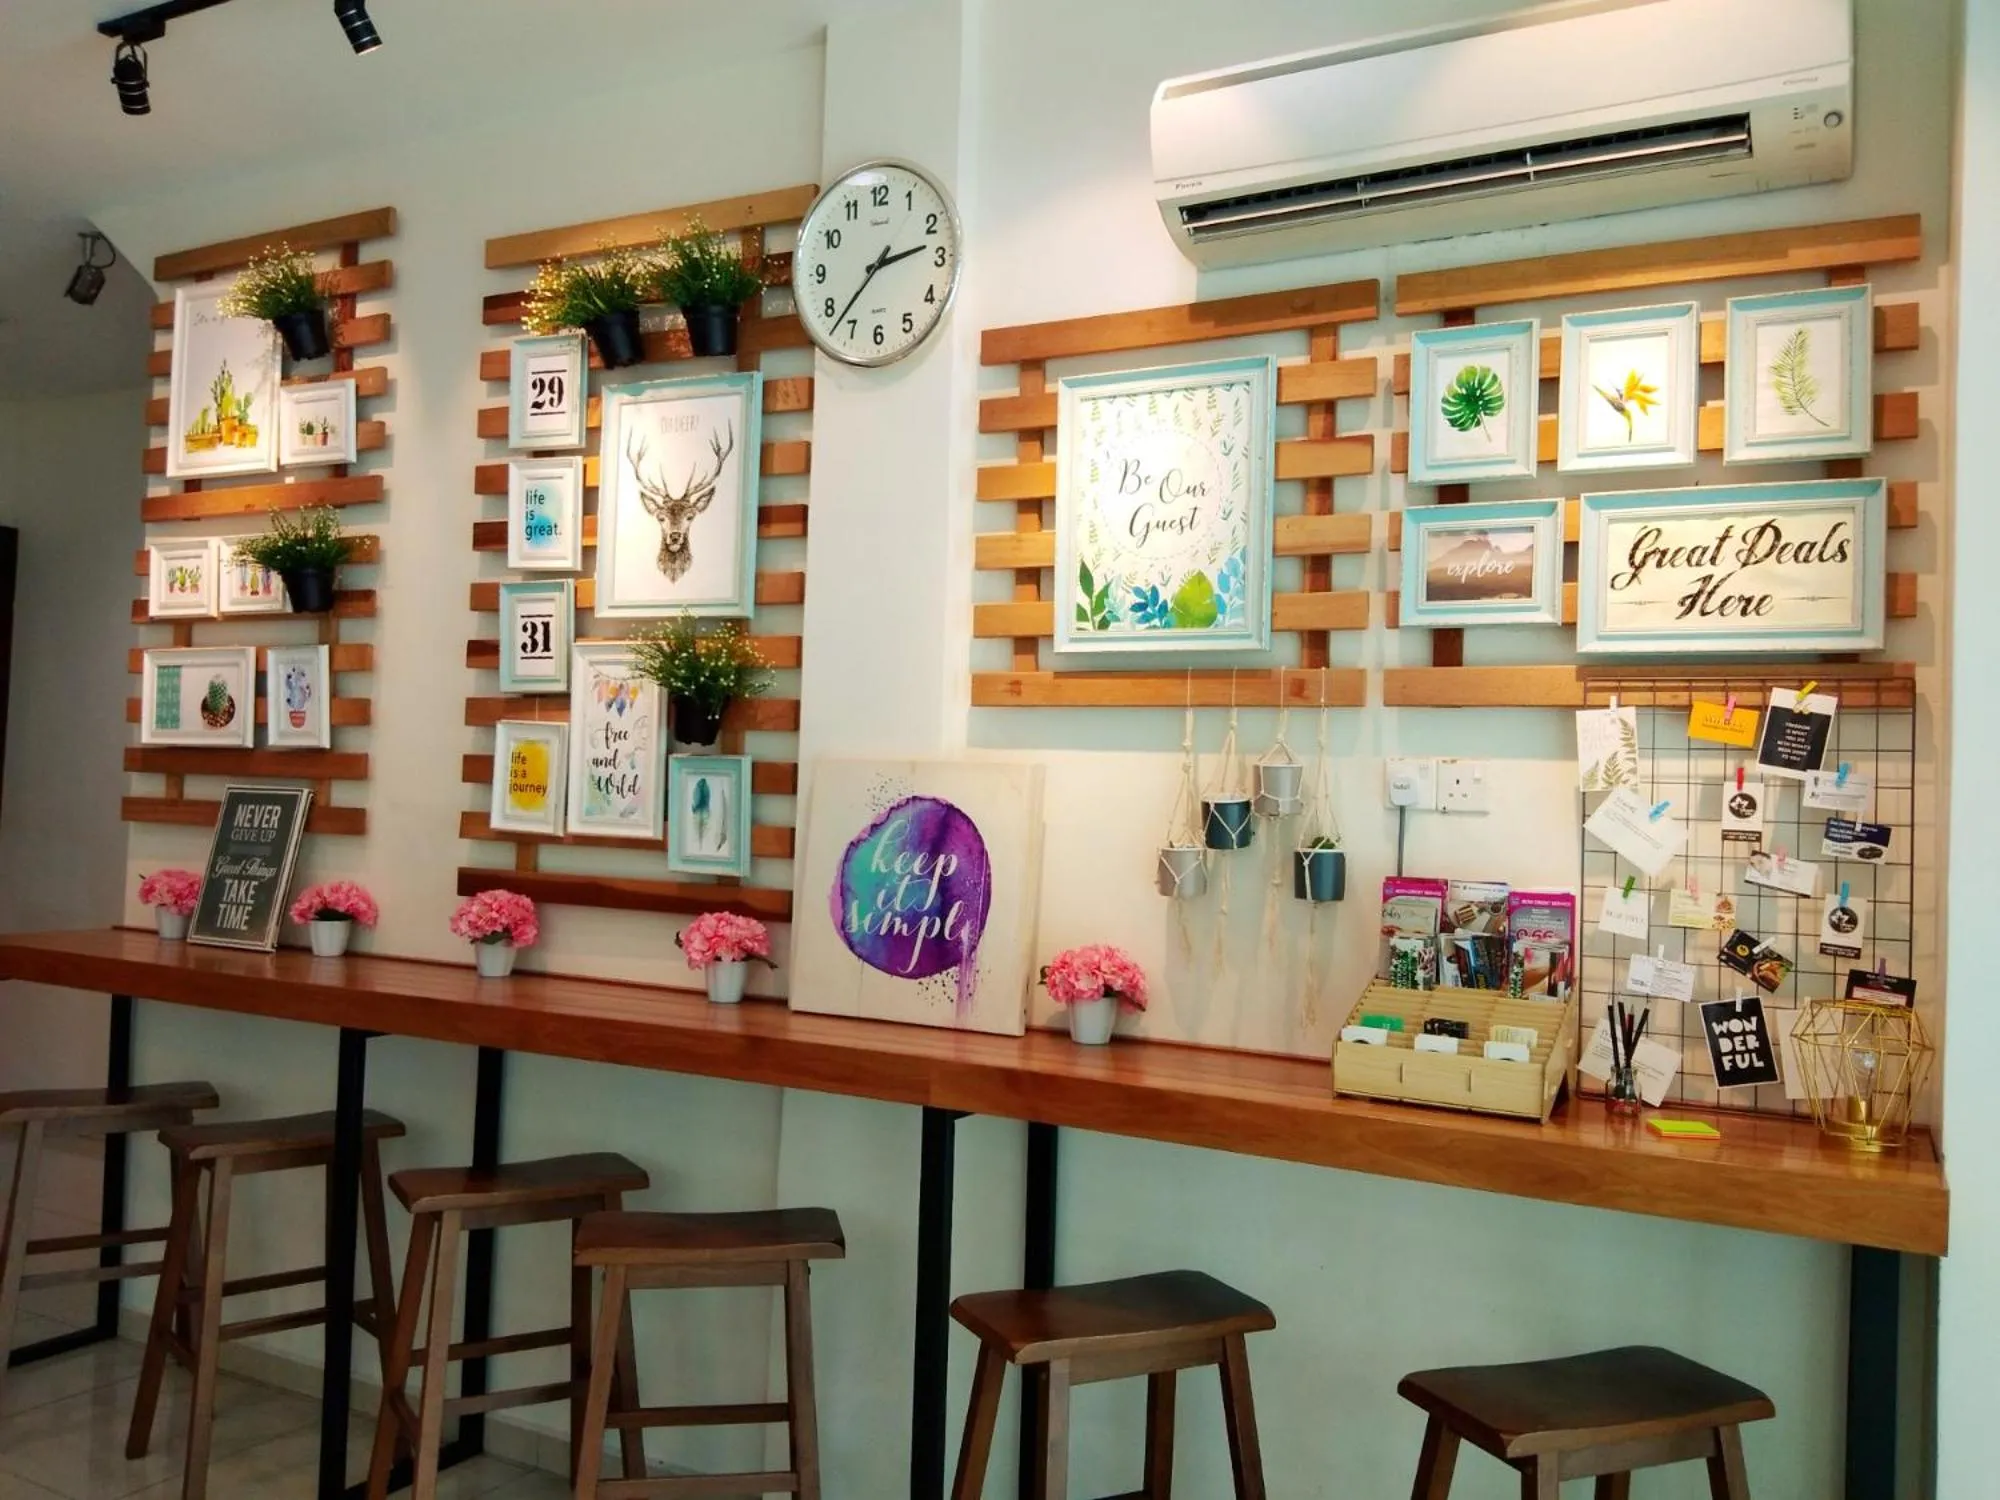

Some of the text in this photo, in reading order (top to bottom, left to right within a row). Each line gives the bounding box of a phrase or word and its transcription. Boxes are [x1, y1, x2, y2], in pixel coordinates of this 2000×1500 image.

[870, 185, 889, 207] 12
[905, 190, 913, 211] 1
[845, 200, 858, 221] 11
[925, 213, 938, 235] 2
[824, 229, 841, 249] 10
[934, 246, 946, 267] 3
[815, 264, 826, 284] 9
[924, 284, 935, 304] 4
[824, 297, 835, 318] 8
[847, 319, 858, 339] 7
[902, 313, 913, 333] 5
[873, 325, 884, 345] 6
[530, 376, 565, 410] 29
[1118, 458, 1208, 504] Be Our
[525, 489, 545, 506] life
[525, 505, 536, 522] is
[1129, 502, 1201, 548] Guest
[1610, 518, 1851, 591] Great Deals
[1447, 551, 1516, 584] explore
[1675, 568, 1775, 620] Here
[520, 620, 552, 654] 31
[604, 721, 630, 750] free
[511, 751, 527, 765] life
[591, 748, 621, 770] and
[510, 767, 527, 778] is a
[508, 779, 548, 797] journey
[233, 803, 282, 829] NEVER
[231, 828, 277, 843] GIVE UP
[212, 856, 278, 881] Good Things
[870, 819, 959, 911] keep
[222, 878, 259, 904] TAKE
[877, 874, 931, 912] it
[216, 904, 252, 931] TIME
[1711, 1015, 1758, 1034] WON
[1718, 1033, 1760, 1053] DER
[1721, 1051, 1765, 1071] FUL
